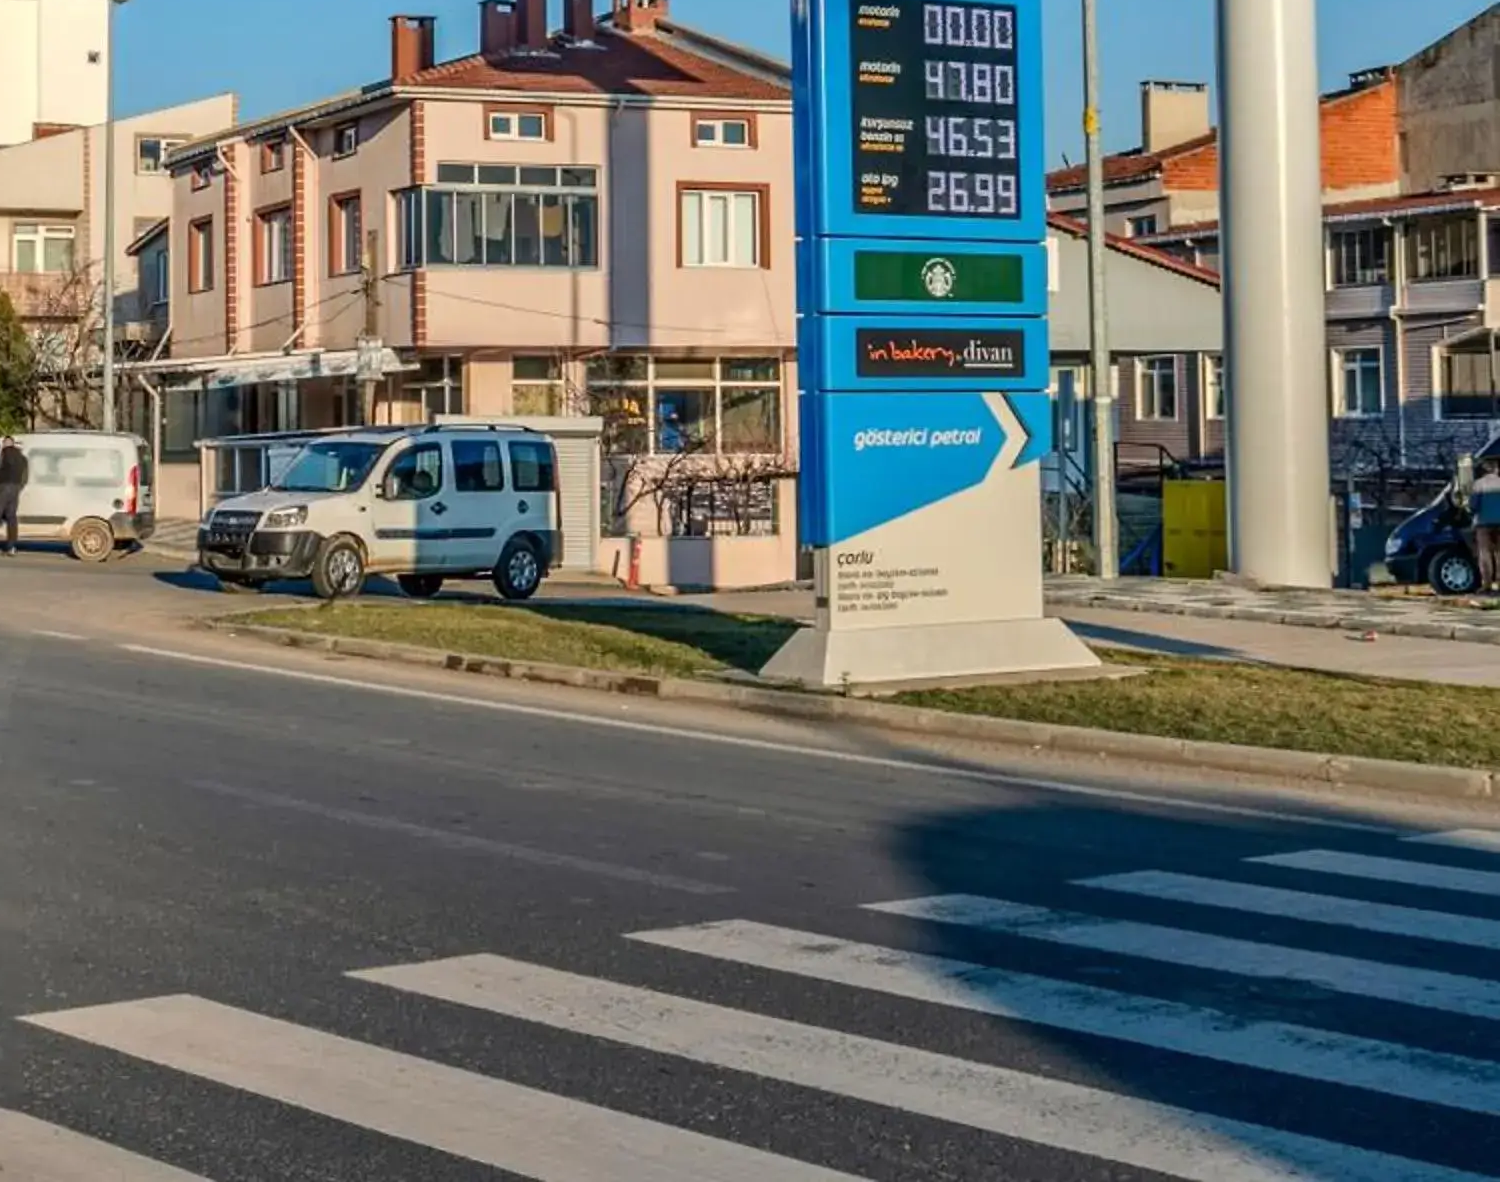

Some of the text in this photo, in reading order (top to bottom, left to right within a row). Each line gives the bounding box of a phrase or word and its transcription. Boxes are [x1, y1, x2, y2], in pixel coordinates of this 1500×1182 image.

[924, 60, 1013, 105] 47.80
[925, 116, 1015, 158] 46.53
[927, 171, 1016, 214] 26.99
[963, 339, 1013, 361] divan
[854, 427, 928, 451] gösterici
